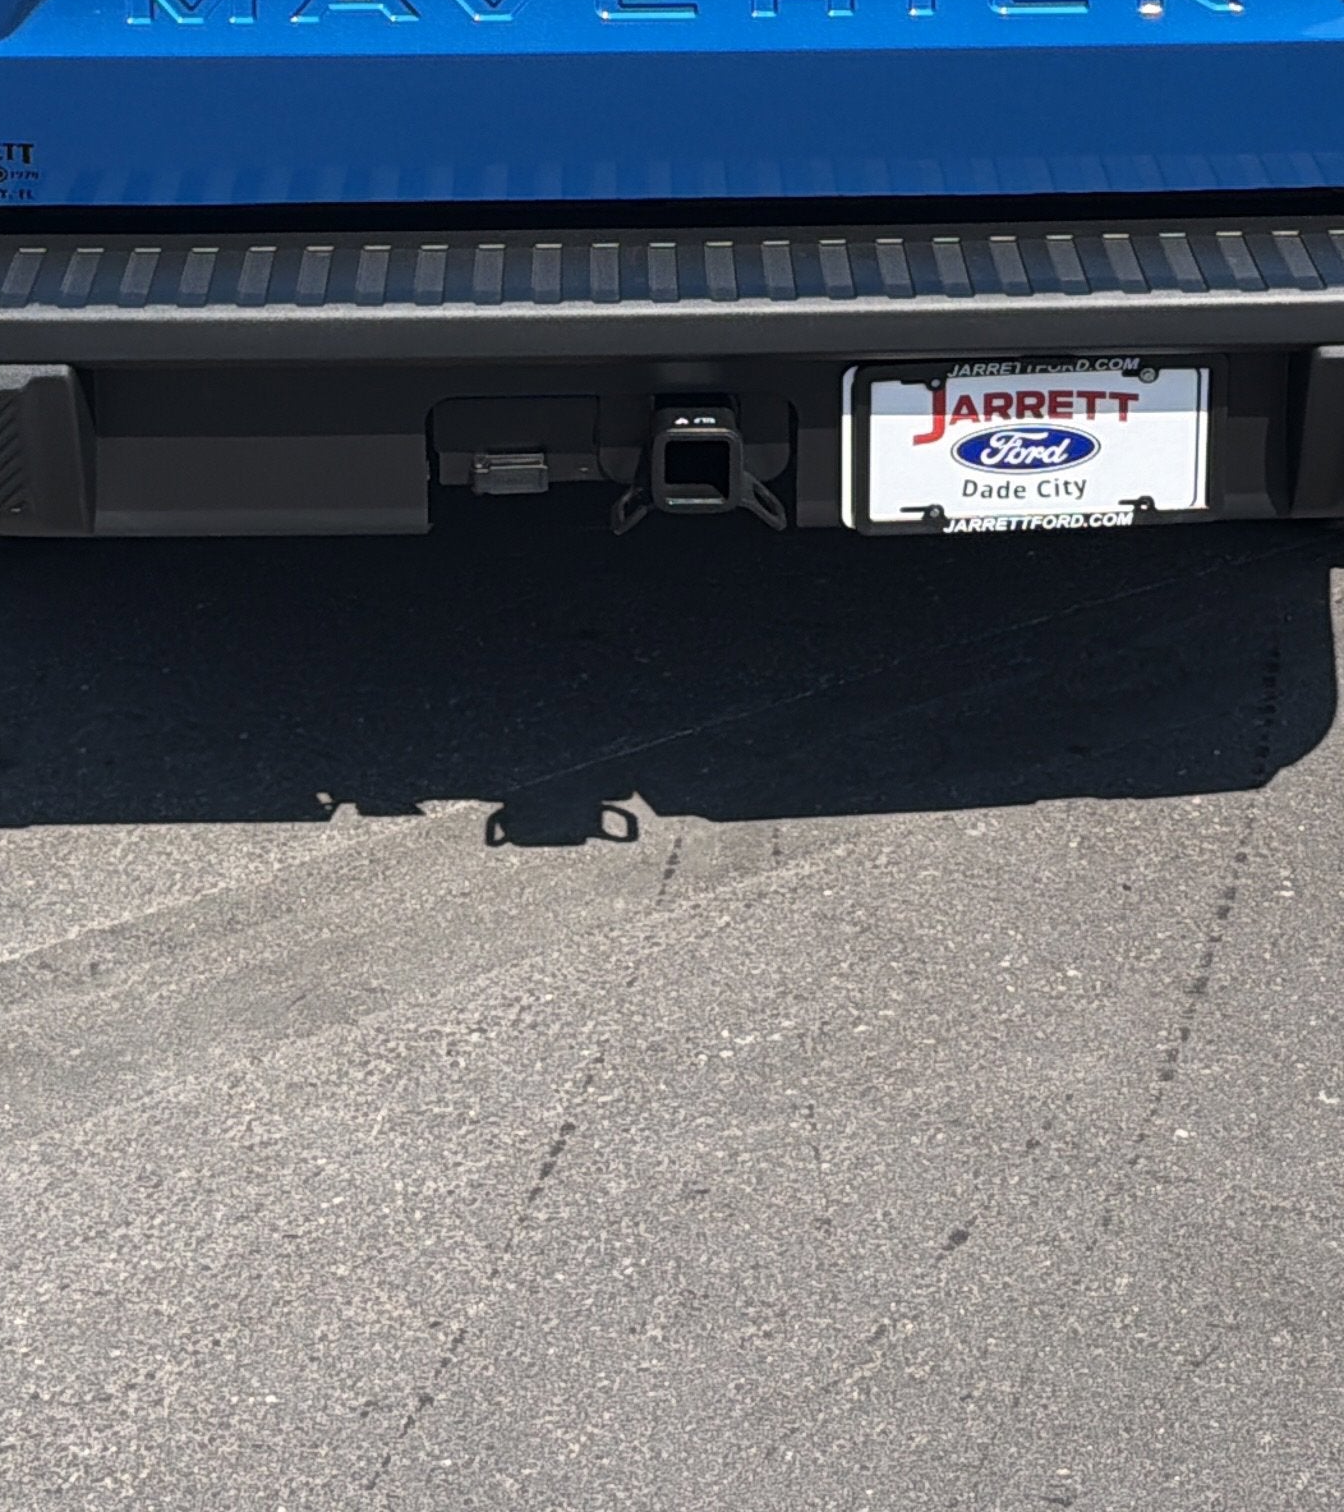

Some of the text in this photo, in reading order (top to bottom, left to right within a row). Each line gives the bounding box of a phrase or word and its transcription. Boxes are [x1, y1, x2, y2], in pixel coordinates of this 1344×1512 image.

[912, 388, 1139, 445] JARRETT
[980, 431, 1070, 466] Ford
[962, 478, 1087, 500] Dade City
[943, 511, 1134, 534] JARRETTFORD.COM
